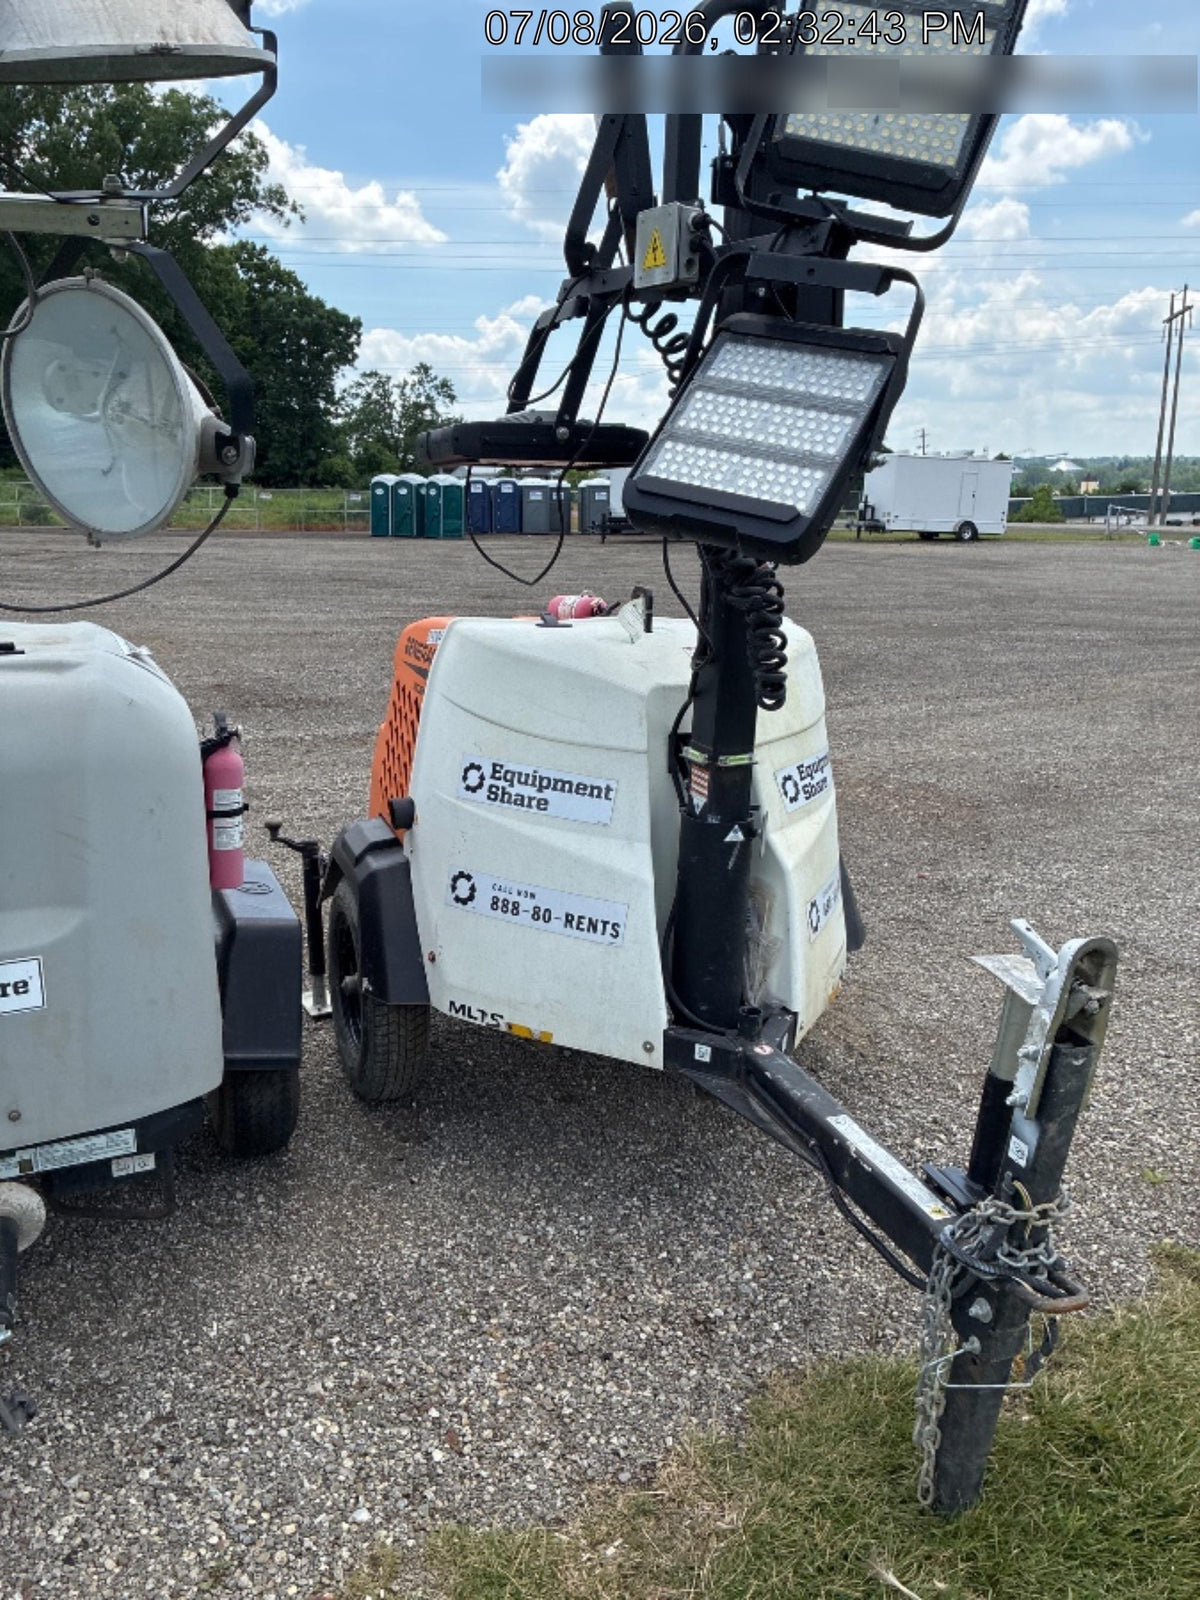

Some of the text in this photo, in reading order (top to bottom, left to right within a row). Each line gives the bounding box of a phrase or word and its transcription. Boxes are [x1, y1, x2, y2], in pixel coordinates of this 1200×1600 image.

[486, 784, 549, 812] Share
[489, 762, 613, 801] Equipment
[490, 895, 621, 939] 888-80-RENTS
